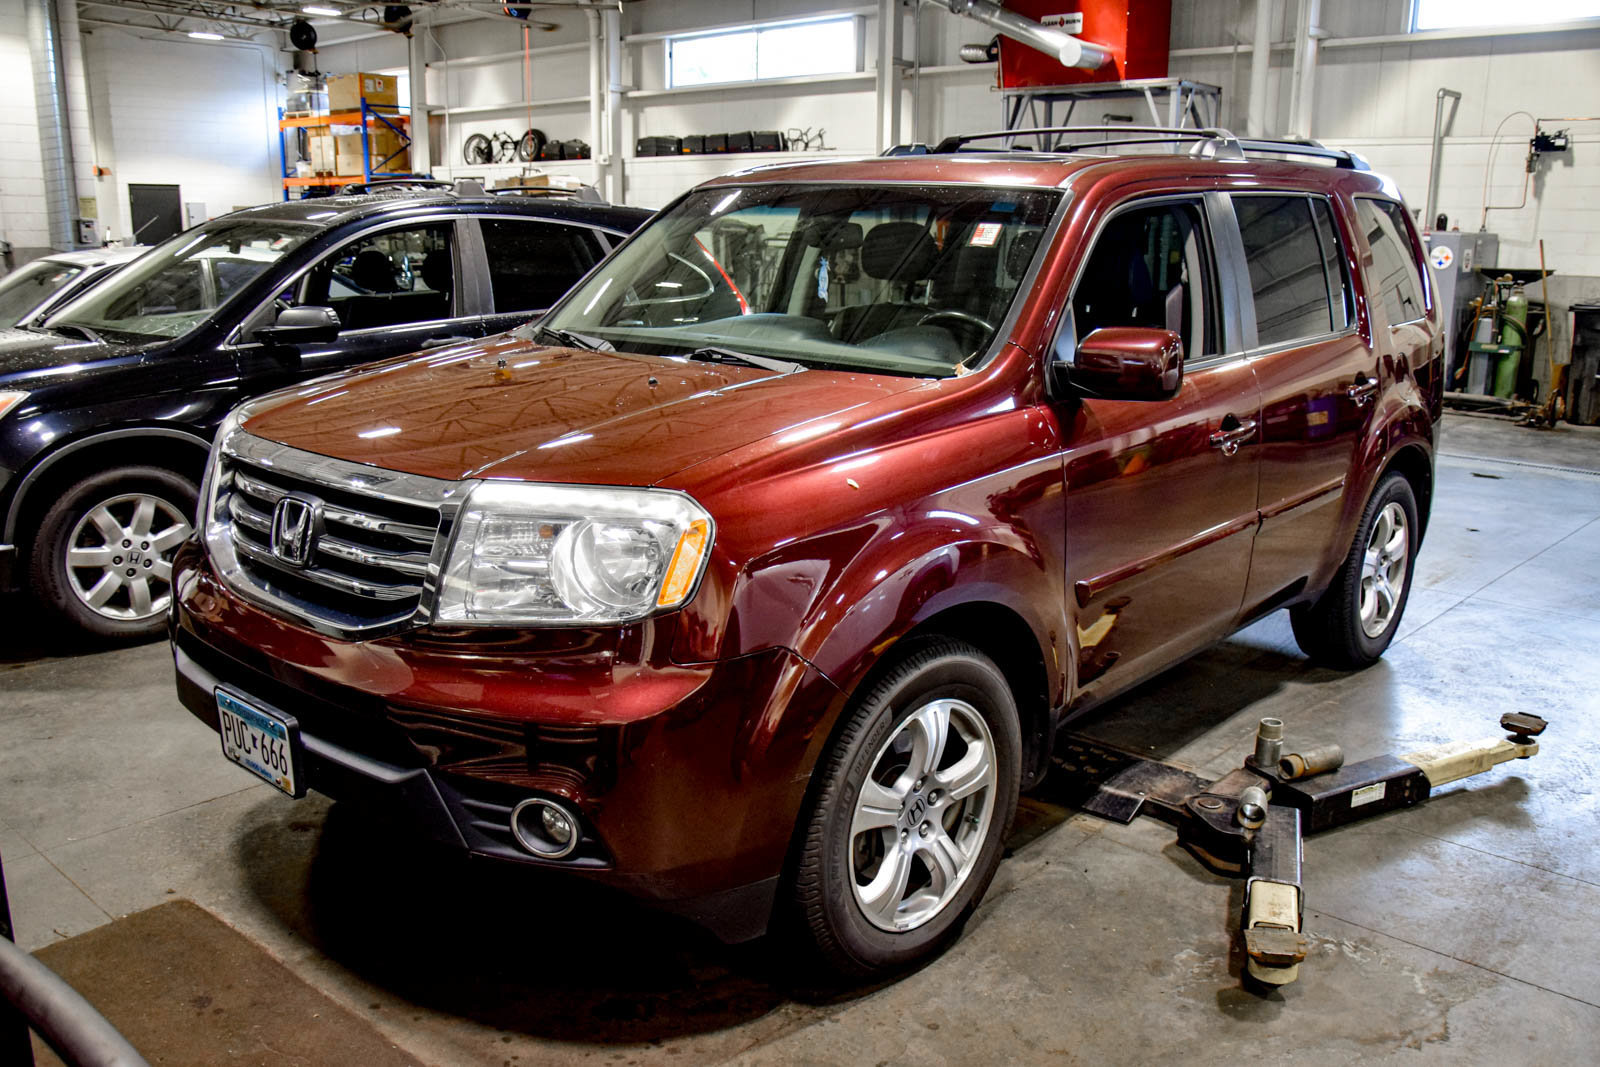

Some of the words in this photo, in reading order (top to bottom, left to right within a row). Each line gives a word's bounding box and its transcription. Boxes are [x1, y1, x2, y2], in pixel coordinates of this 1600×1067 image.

[222, 710, 252, 755] PUC
[261, 732, 288, 776] 666
[854, 720, 886, 775] DEFENDER
